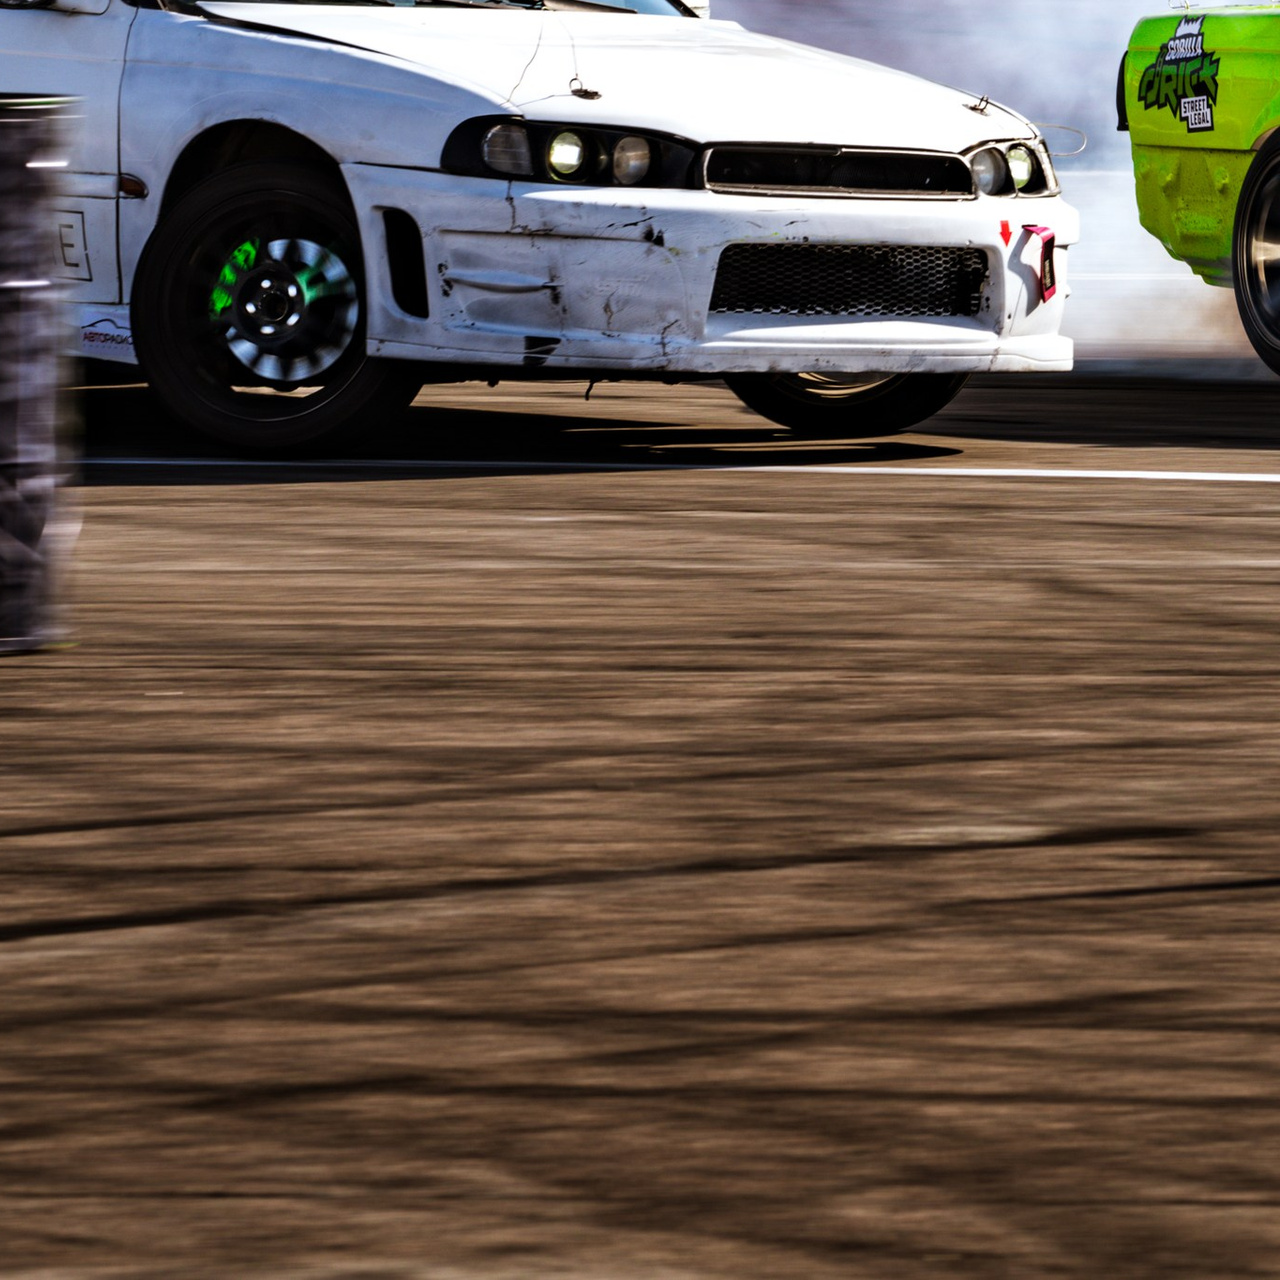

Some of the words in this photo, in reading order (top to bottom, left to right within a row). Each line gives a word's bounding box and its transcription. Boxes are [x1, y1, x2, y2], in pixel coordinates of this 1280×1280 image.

[1165, 35, 1203, 61] GORILLA
[1183, 98, 1206, 114] STREET
[1190, 111, 1210, 126] LEGAL
